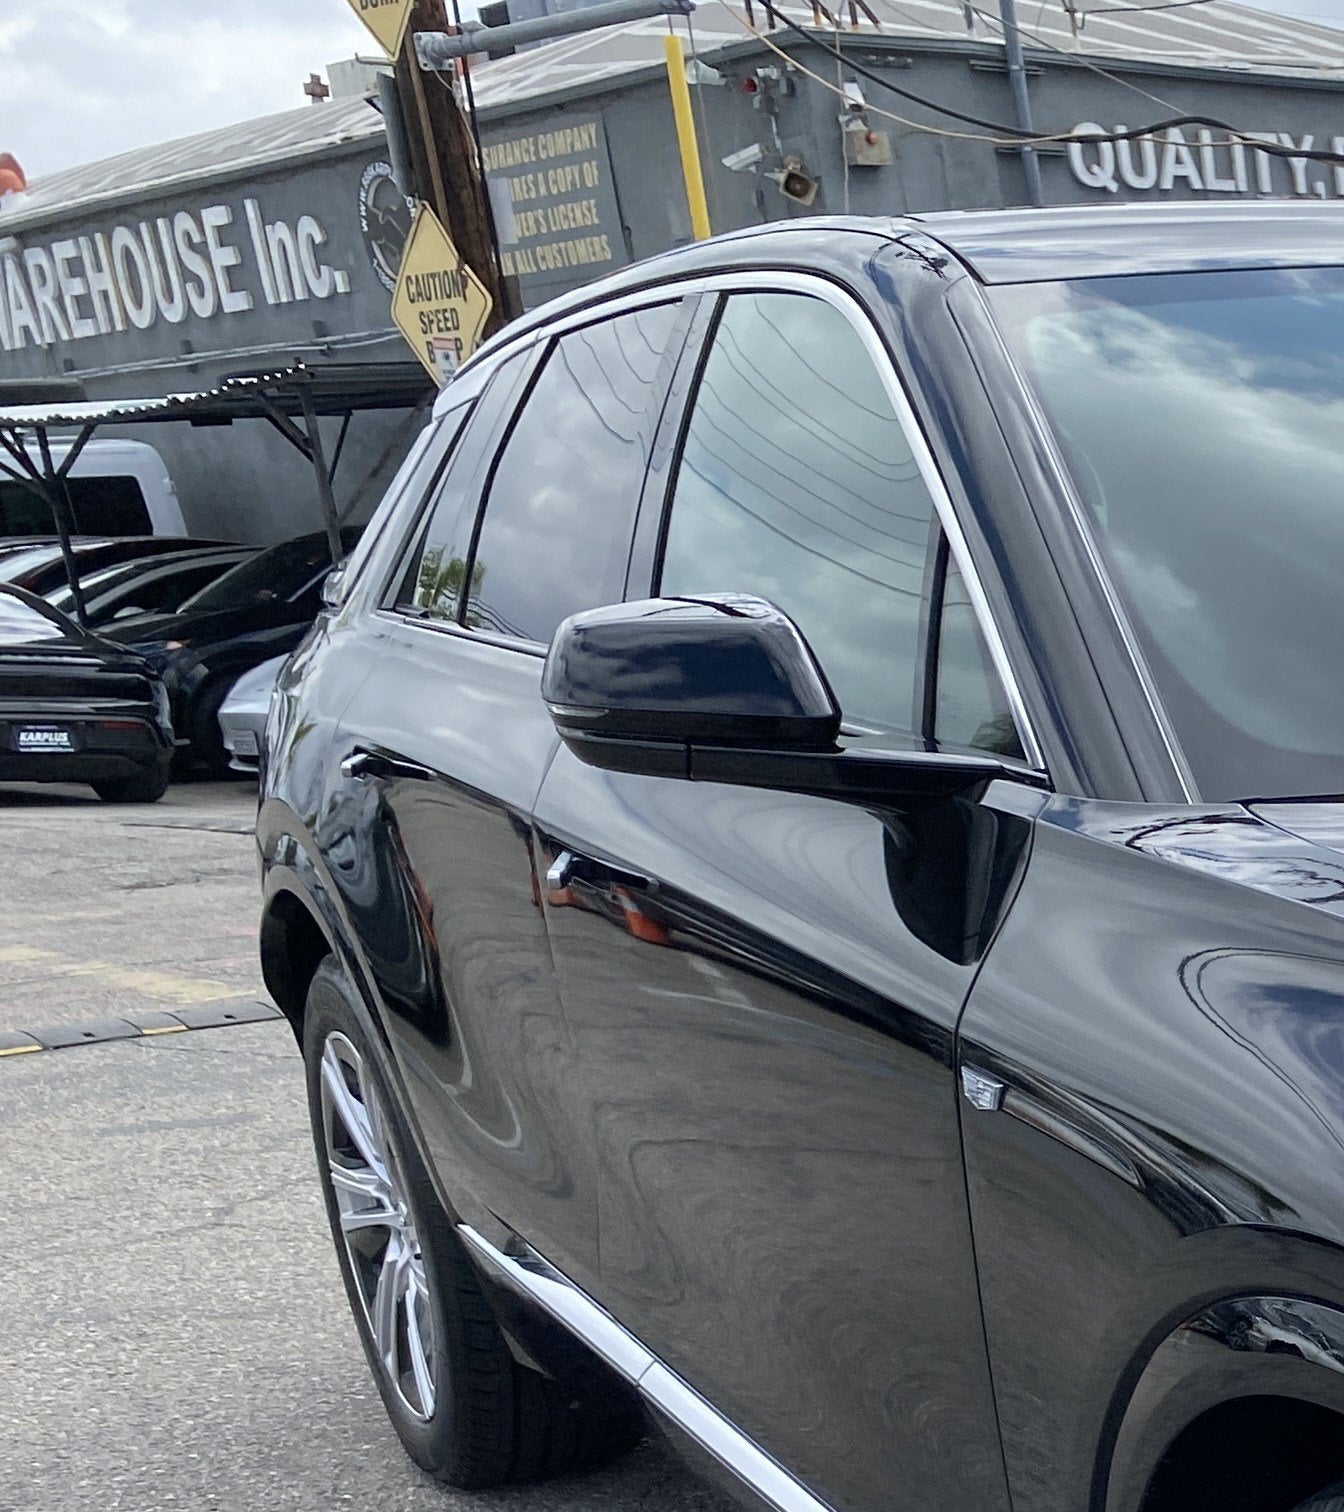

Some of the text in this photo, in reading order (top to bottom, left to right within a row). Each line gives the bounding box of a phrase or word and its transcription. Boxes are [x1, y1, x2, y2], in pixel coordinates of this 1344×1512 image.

[482, 123, 597, 172] SURANCE COMPANY
[548, 165, 581, 195] COPY
[582, 160, 599, 188] OF
[548, 199, 600, 232] LICENSE
[244, 199, 351, 305] Inc.
[515, 248, 538, 275] ALL
[535, 234, 612, 271] CUSTOMERS
[405, 269, 464, 304] CAUTION
[418, 307, 460, 335] SPEED
[426, 337, 463, 364] BP
